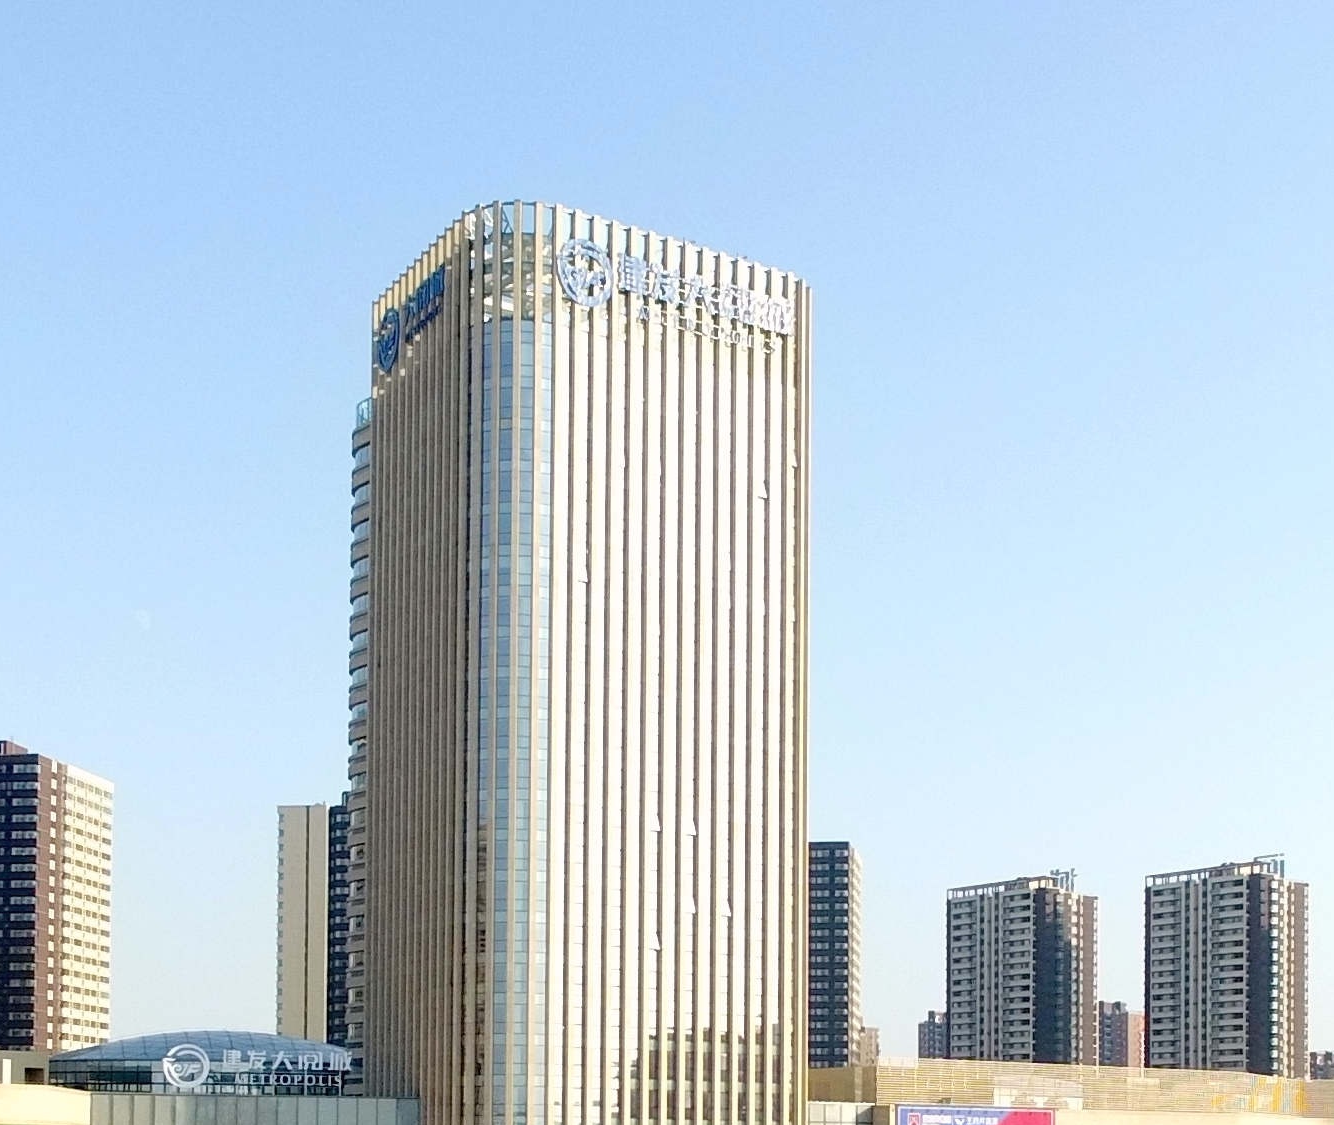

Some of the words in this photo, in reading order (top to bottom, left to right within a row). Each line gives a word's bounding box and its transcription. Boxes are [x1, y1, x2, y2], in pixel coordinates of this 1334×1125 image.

[222, 1049, 353, 1072] 建发大阅城
[234, 1073, 342, 1087] METROPOLIS
